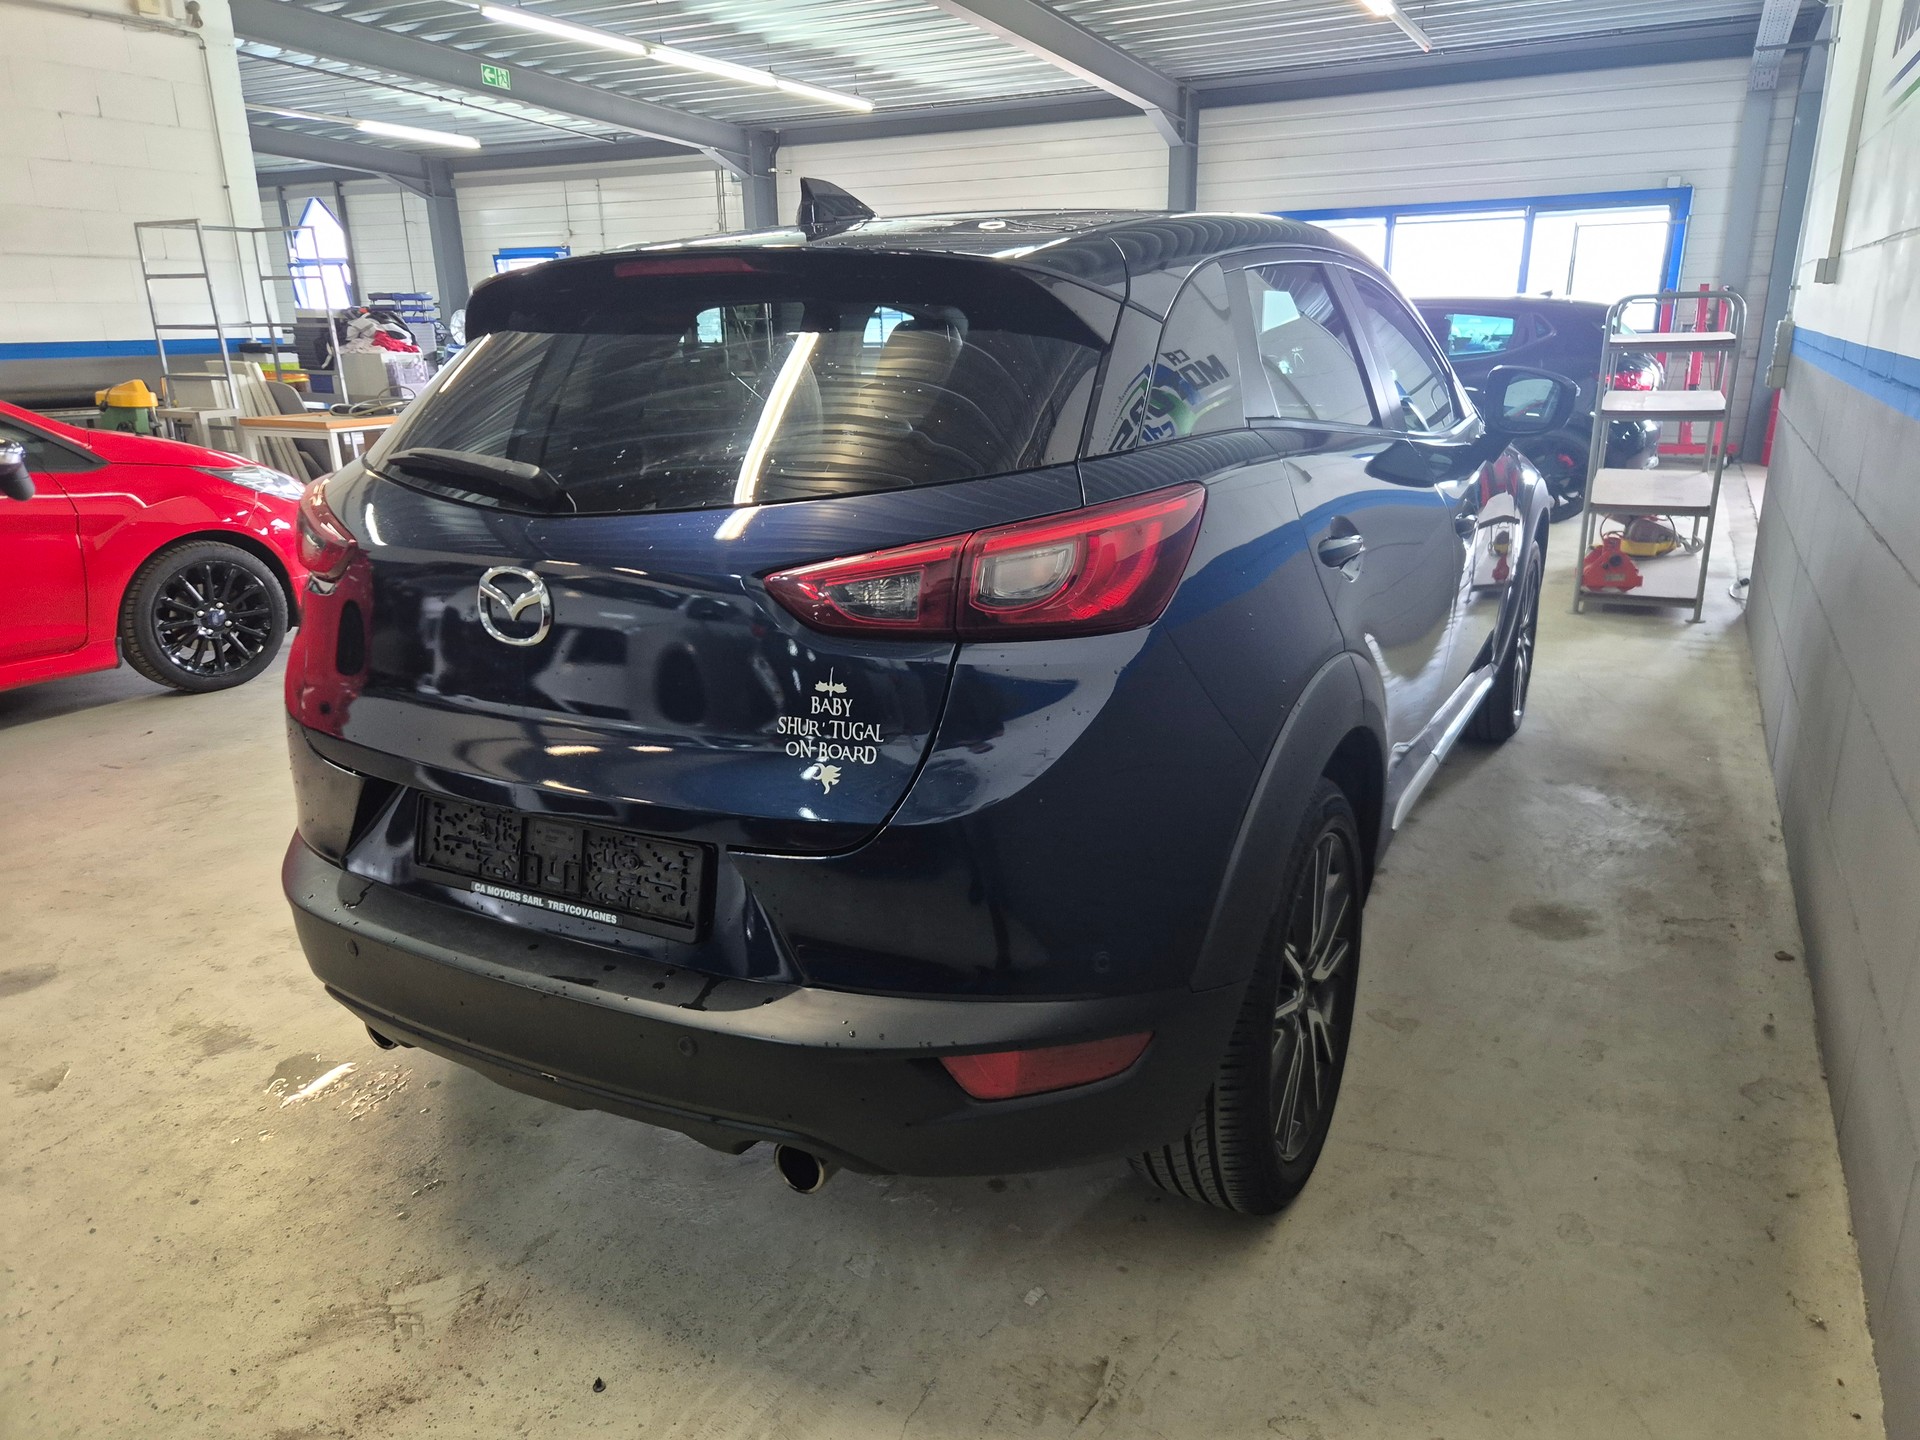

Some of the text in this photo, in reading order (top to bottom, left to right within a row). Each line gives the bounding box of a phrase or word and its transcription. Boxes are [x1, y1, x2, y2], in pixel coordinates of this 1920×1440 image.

[811, 696, 853, 717] BABY
[785, 740, 877, 765] ON BOARD
[474, 883, 617, 924] CA MOTORS SARL TREYCOVAGNES
